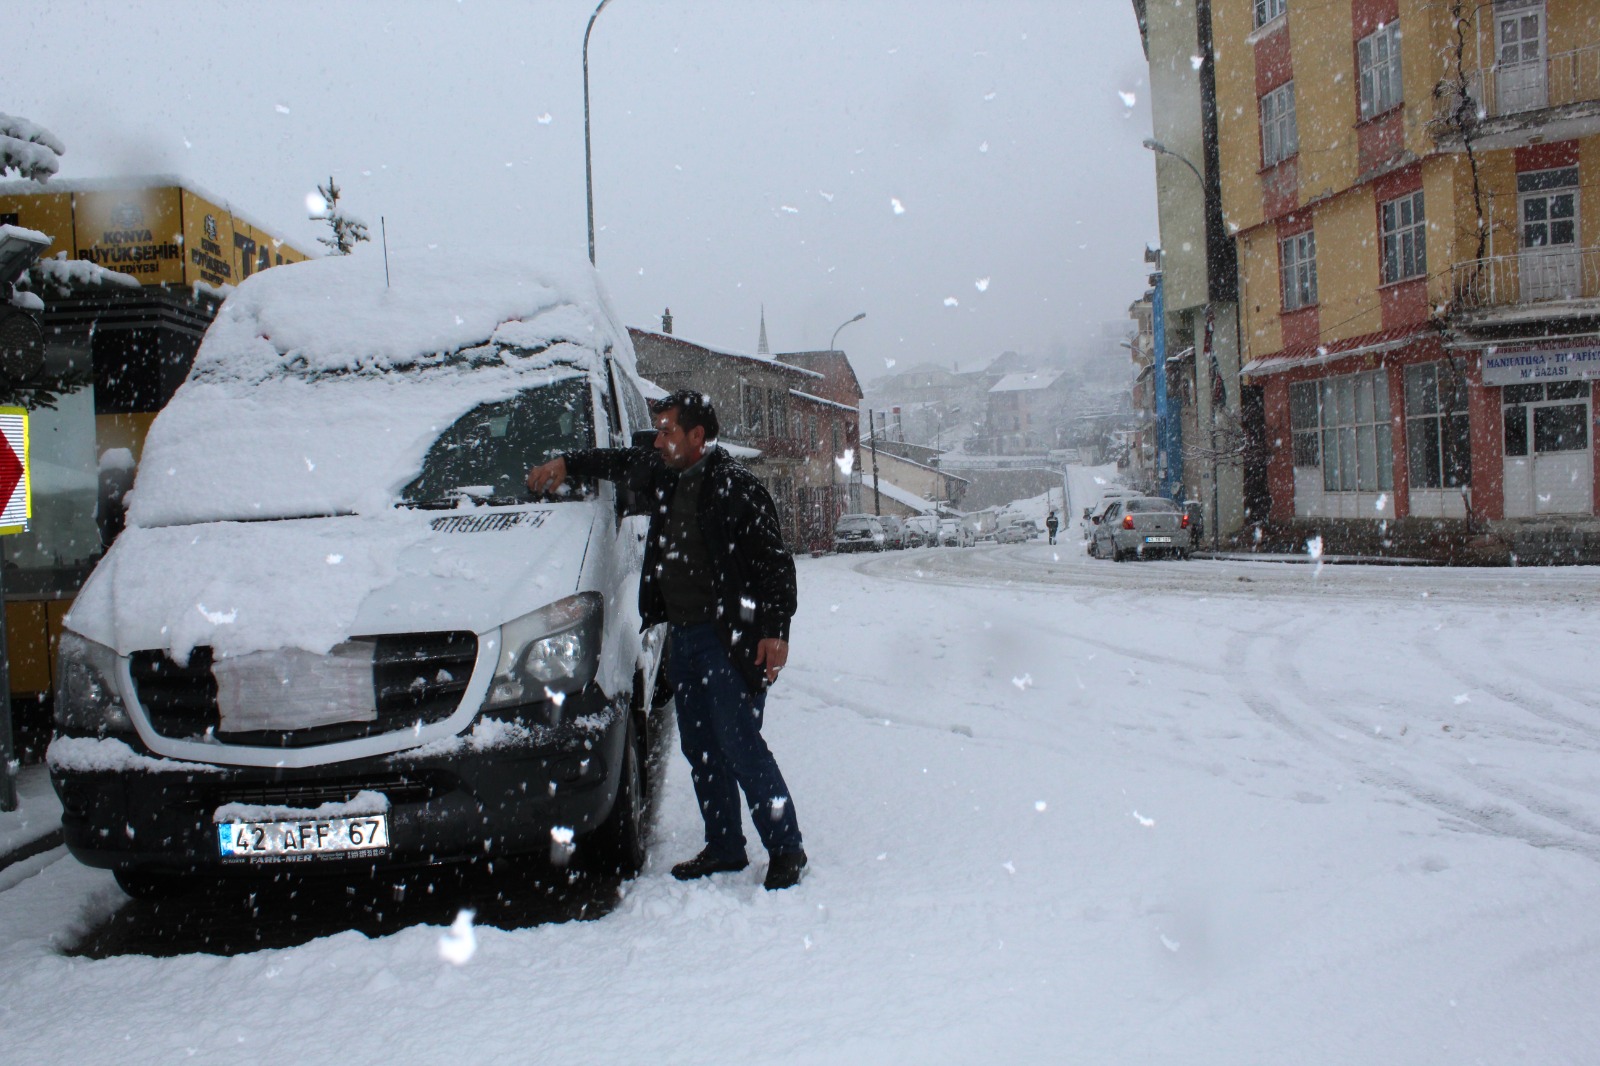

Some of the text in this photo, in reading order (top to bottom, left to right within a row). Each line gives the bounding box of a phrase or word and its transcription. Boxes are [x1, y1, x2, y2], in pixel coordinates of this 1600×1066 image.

[104, 229, 153, 244] KONYA
[78, 240, 179, 263] BÜYÜKŞEHİR
[105, 261, 159, 274] ELEDİYESİ
[236, 820, 380, 851] 42 AFF 67
